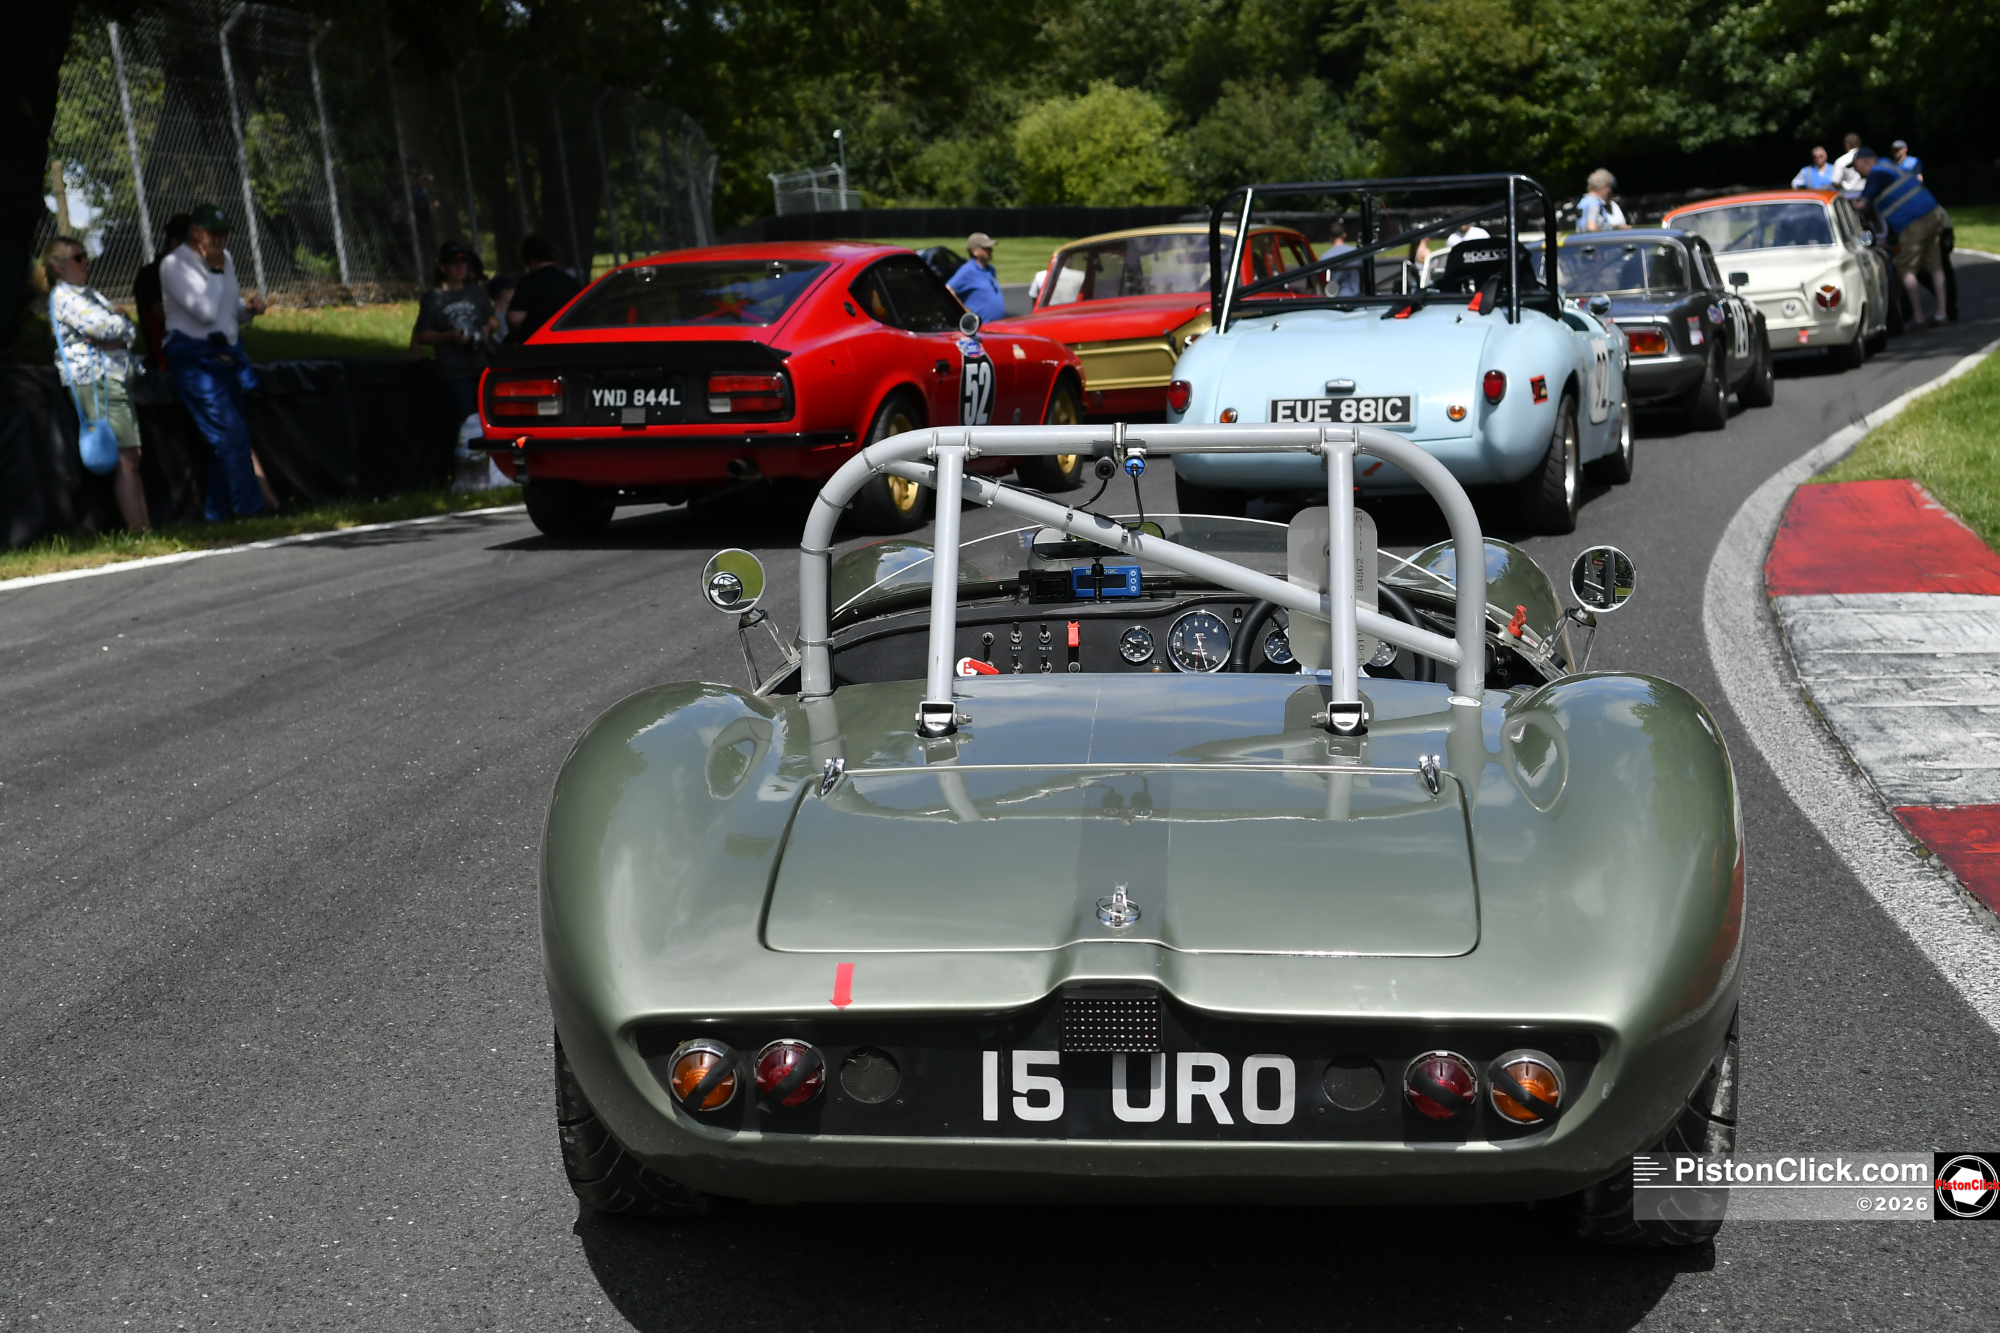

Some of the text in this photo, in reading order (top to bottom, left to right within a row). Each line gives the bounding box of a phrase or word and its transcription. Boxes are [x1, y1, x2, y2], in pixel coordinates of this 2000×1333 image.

[592, 387, 681, 407] YND 844L
[964, 361, 991, 426] 52
[1276, 398, 1403, 423] EUE 881C
[1356, 558, 1364, 591] 84862
[982, 1050, 1296, 1125] 15 URO
